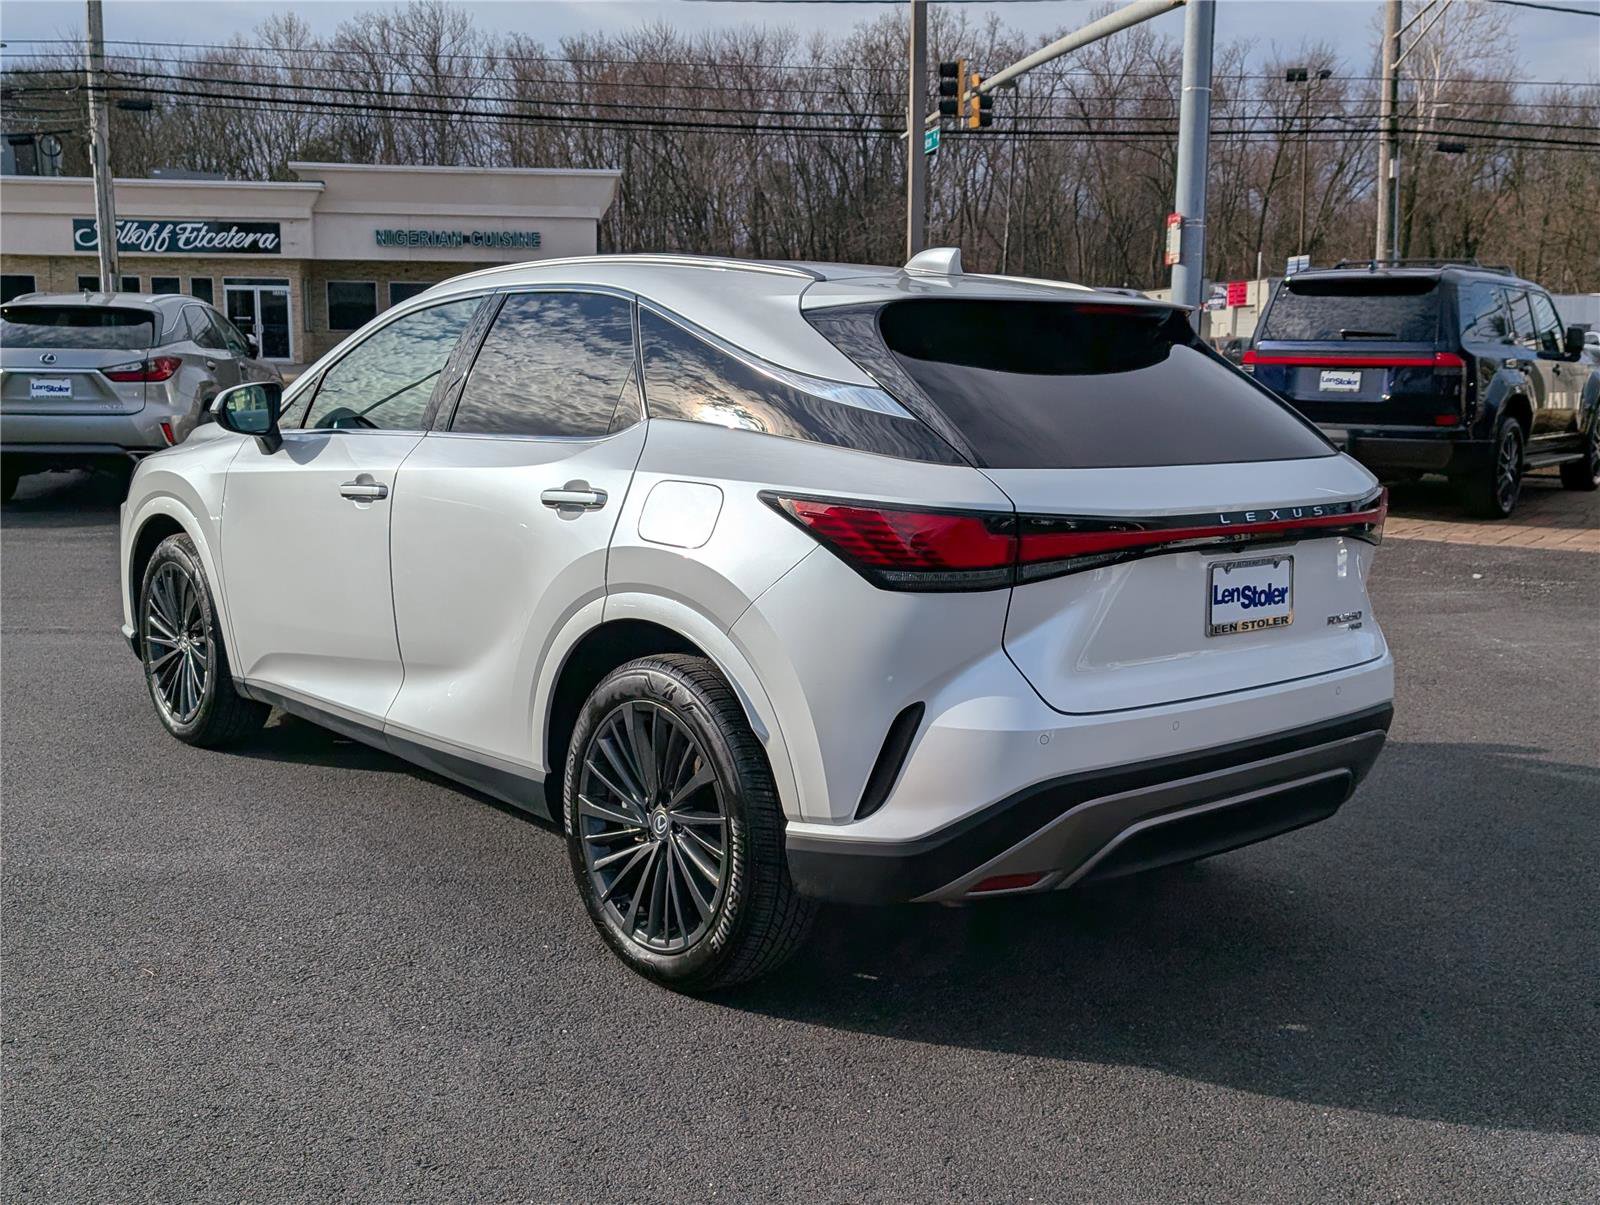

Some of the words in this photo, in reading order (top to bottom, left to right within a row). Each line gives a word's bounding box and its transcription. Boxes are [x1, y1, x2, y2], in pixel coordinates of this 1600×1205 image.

[175, 223, 279, 250] Etcetera
[375, 230, 464, 248] NIGERIAN
[470, 231, 541, 249] CUISINE
[1220, 506, 1323, 524] LEXUS
[1214, 623, 1238, 634] LEN
[1241, 616, 1289, 631] STOLER
[709, 816, 746, 954] BRIDGESTONE
